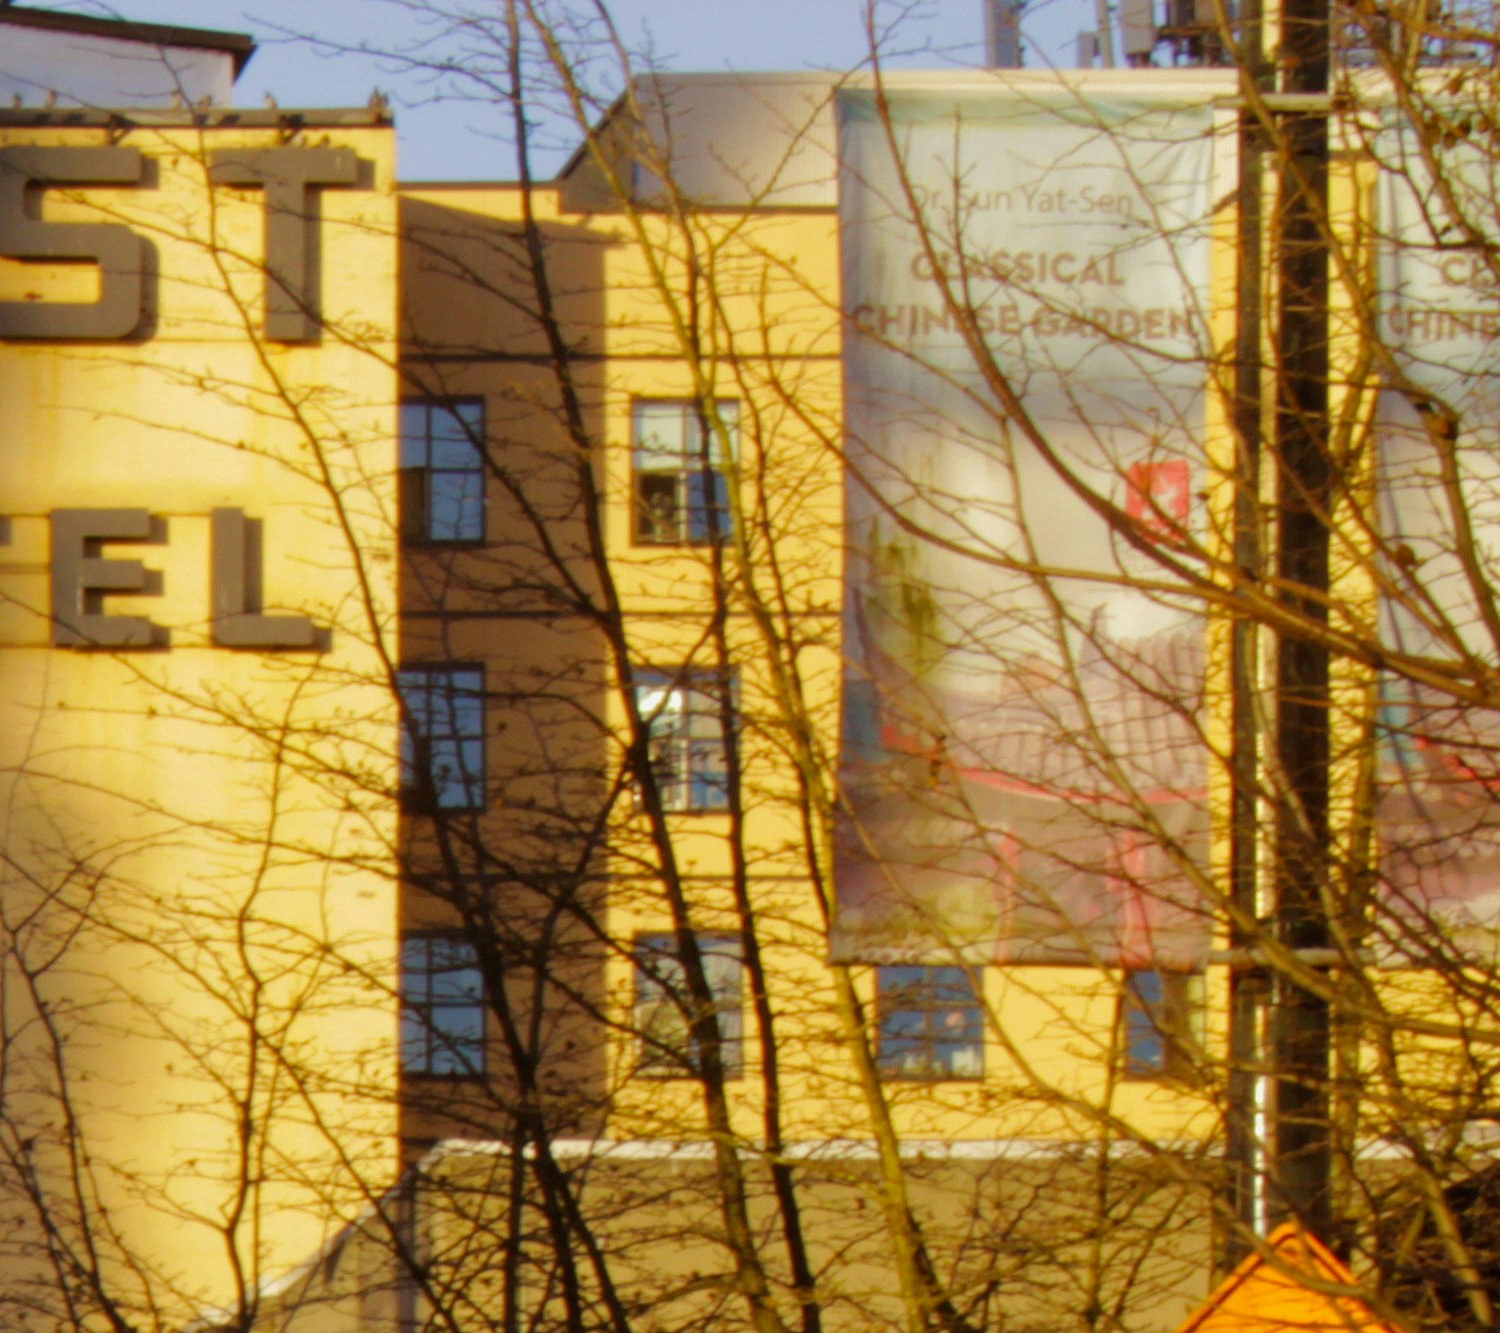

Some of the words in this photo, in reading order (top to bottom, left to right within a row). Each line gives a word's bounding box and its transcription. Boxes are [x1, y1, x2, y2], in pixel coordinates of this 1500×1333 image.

[1018, 184, 1133, 216] Yat-Sen
[911, 250, 1126, 286] CLASSICAL
[1031, 305, 1197, 339] GARDEN
